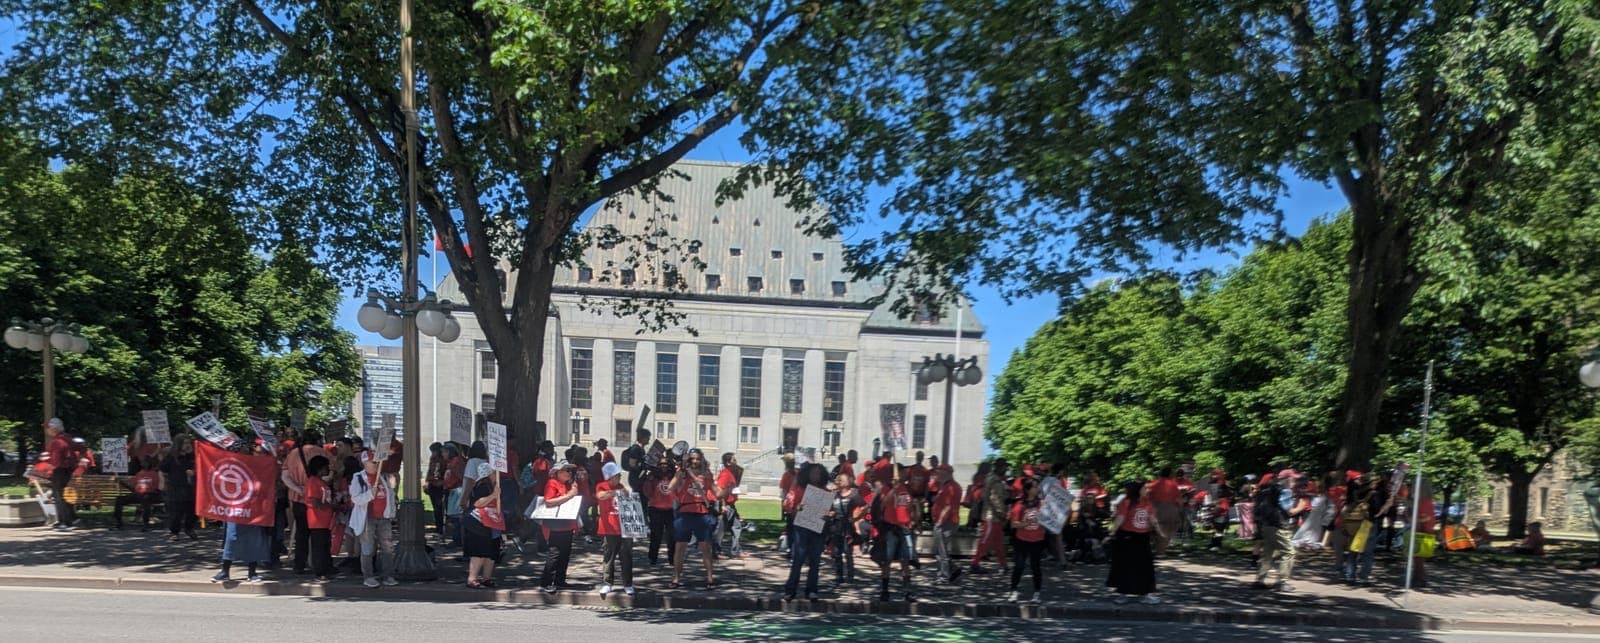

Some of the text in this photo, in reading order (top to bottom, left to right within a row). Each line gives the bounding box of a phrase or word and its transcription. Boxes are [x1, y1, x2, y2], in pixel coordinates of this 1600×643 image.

[208, 504, 252, 518] ACORN
[620, 514, 644, 524] HUMAN
[623, 523, 646, 533] RIGHT
